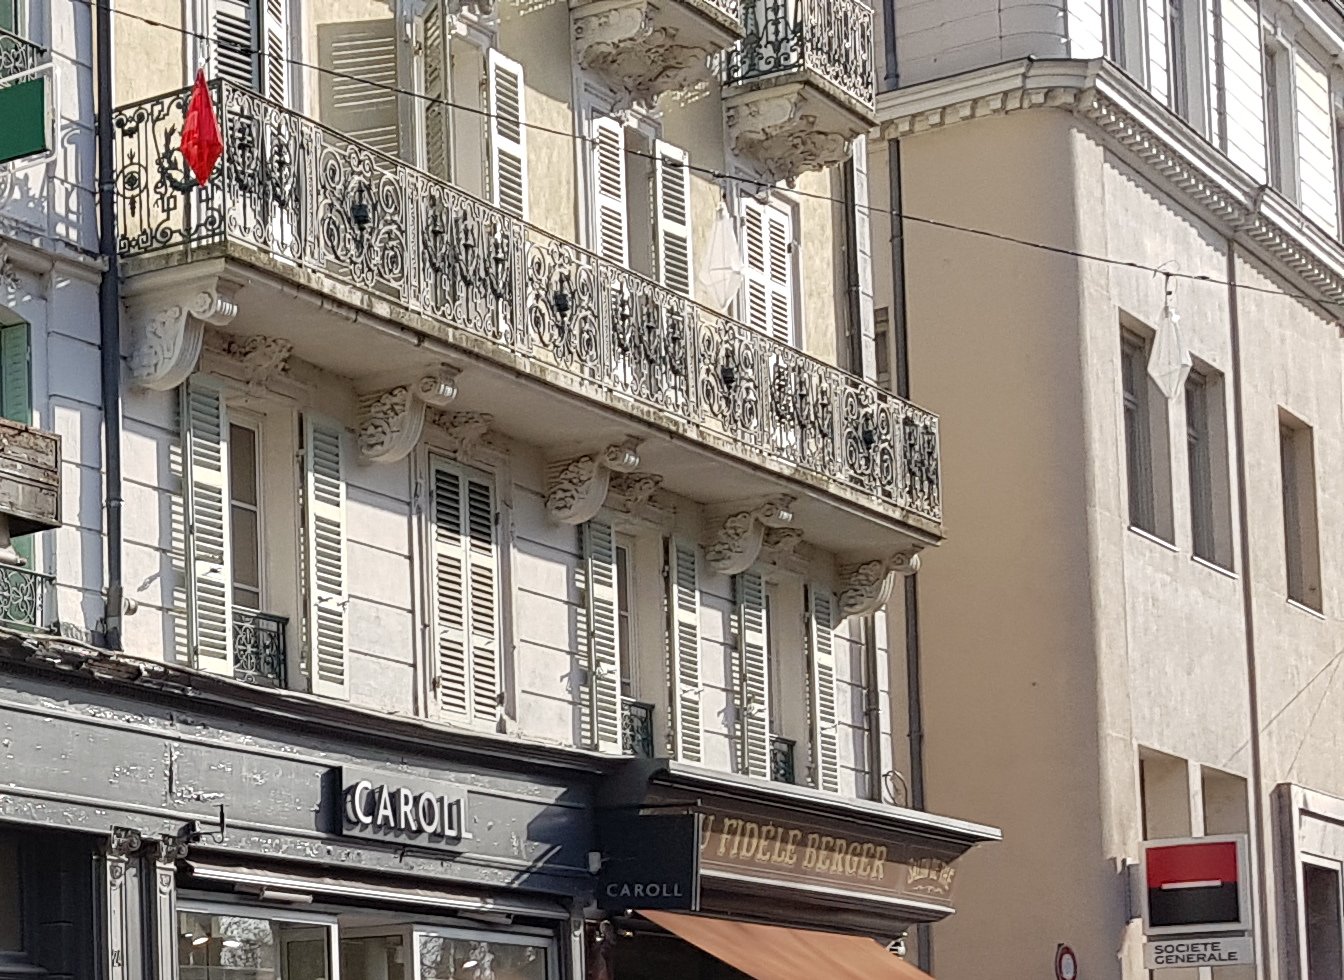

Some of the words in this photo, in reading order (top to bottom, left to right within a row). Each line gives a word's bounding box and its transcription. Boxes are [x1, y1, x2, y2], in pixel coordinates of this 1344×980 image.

[352, 780, 474, 839] CAROLL
[803, 833, 888, 881] BERGER
[606, 883, 683, 899] CAROLL
[1154, 942, 1221, 955] SOCIETE
[1154, 952, 1238, 965] GENERALE
